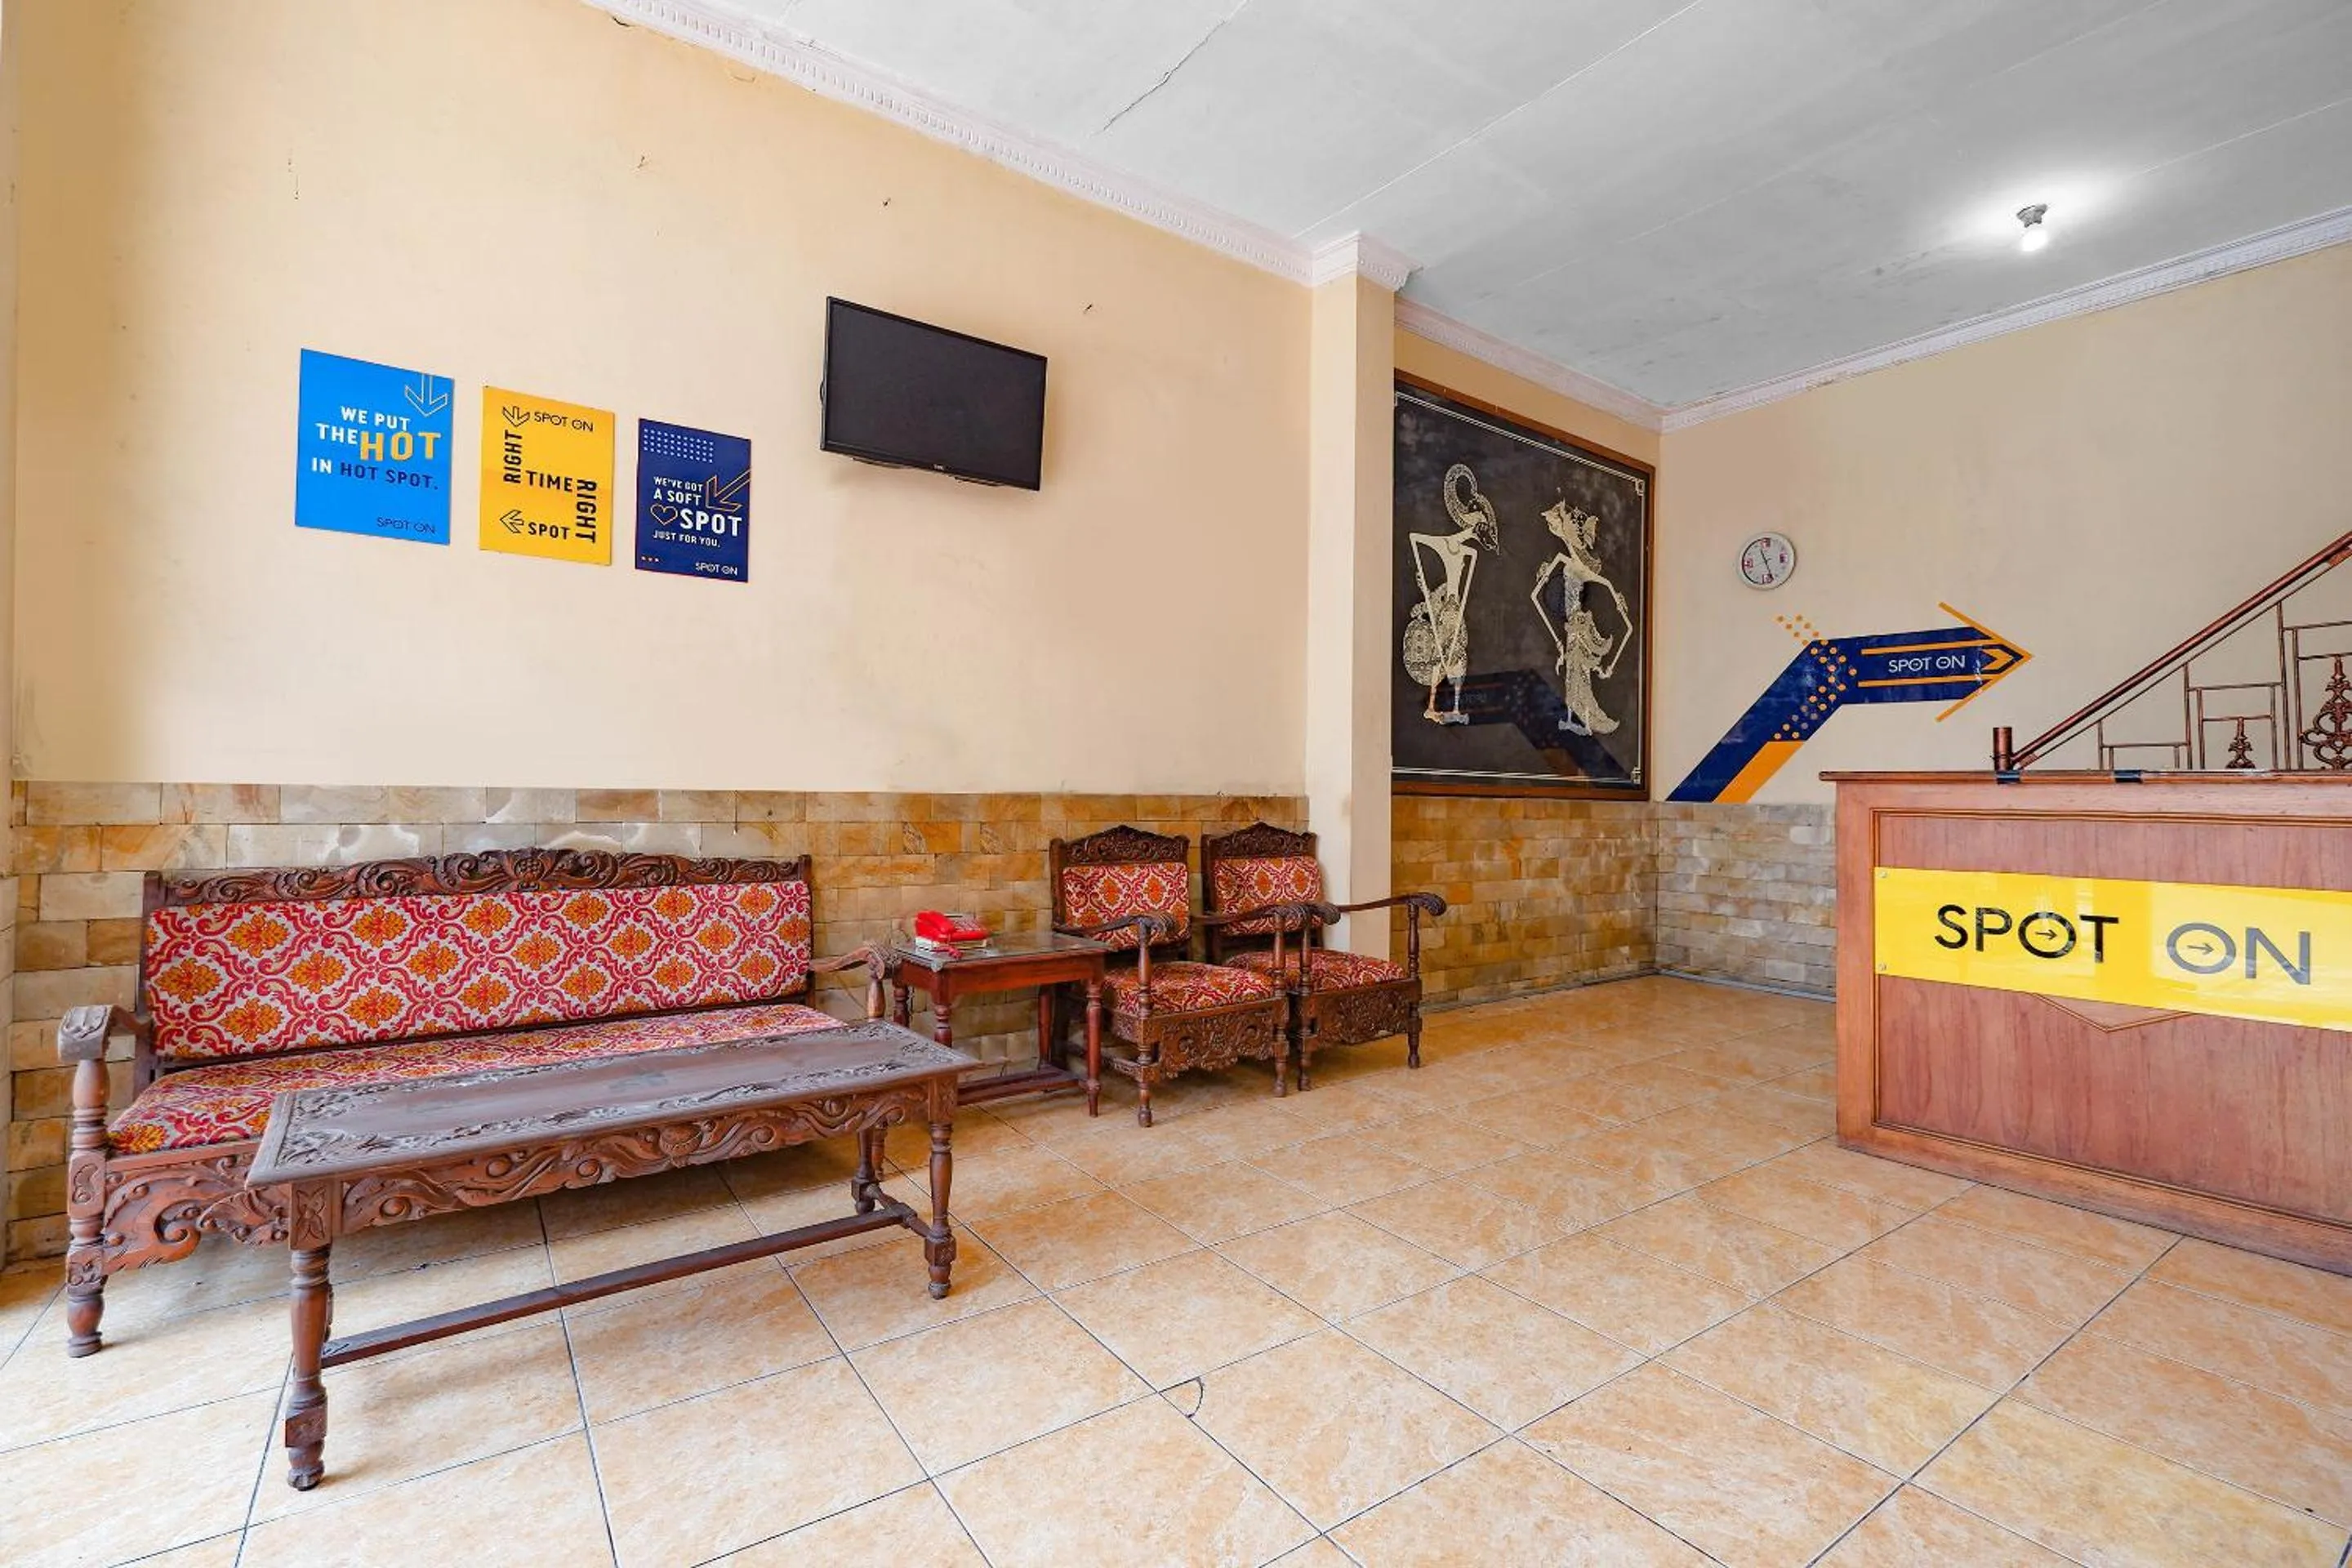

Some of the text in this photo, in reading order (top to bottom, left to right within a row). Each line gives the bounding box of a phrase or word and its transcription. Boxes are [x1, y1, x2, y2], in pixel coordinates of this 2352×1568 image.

[340, 406, 410, 431] WE PUT
[534, 411, 594, 432] SPOT ON
[315, 423, 441, 461] THE HOT
[503, 429, 523, 483] RIGHT
[312, 457, 439, 490] IN HOT SPOT.
[526, 470, 572, 492] TIME
[653, 476, 703, 492] WE'VE GOT
[653, 488, 702, 506] A SOFT
[575, 479, 597, 544] RIGHT
[376, 517, 435, 534] SPOT ON
[528, 521, 570, 540] SPOT
[679, 508, 742, 537] SPOT
[653, 530, 720, 548] JUST FOR YOU.
[695, 562, 738, 576] SPOT ON
[1888, 655, 1966, 673] SPOT ON
[1934, 903, 2311, 985] SPOT ON
